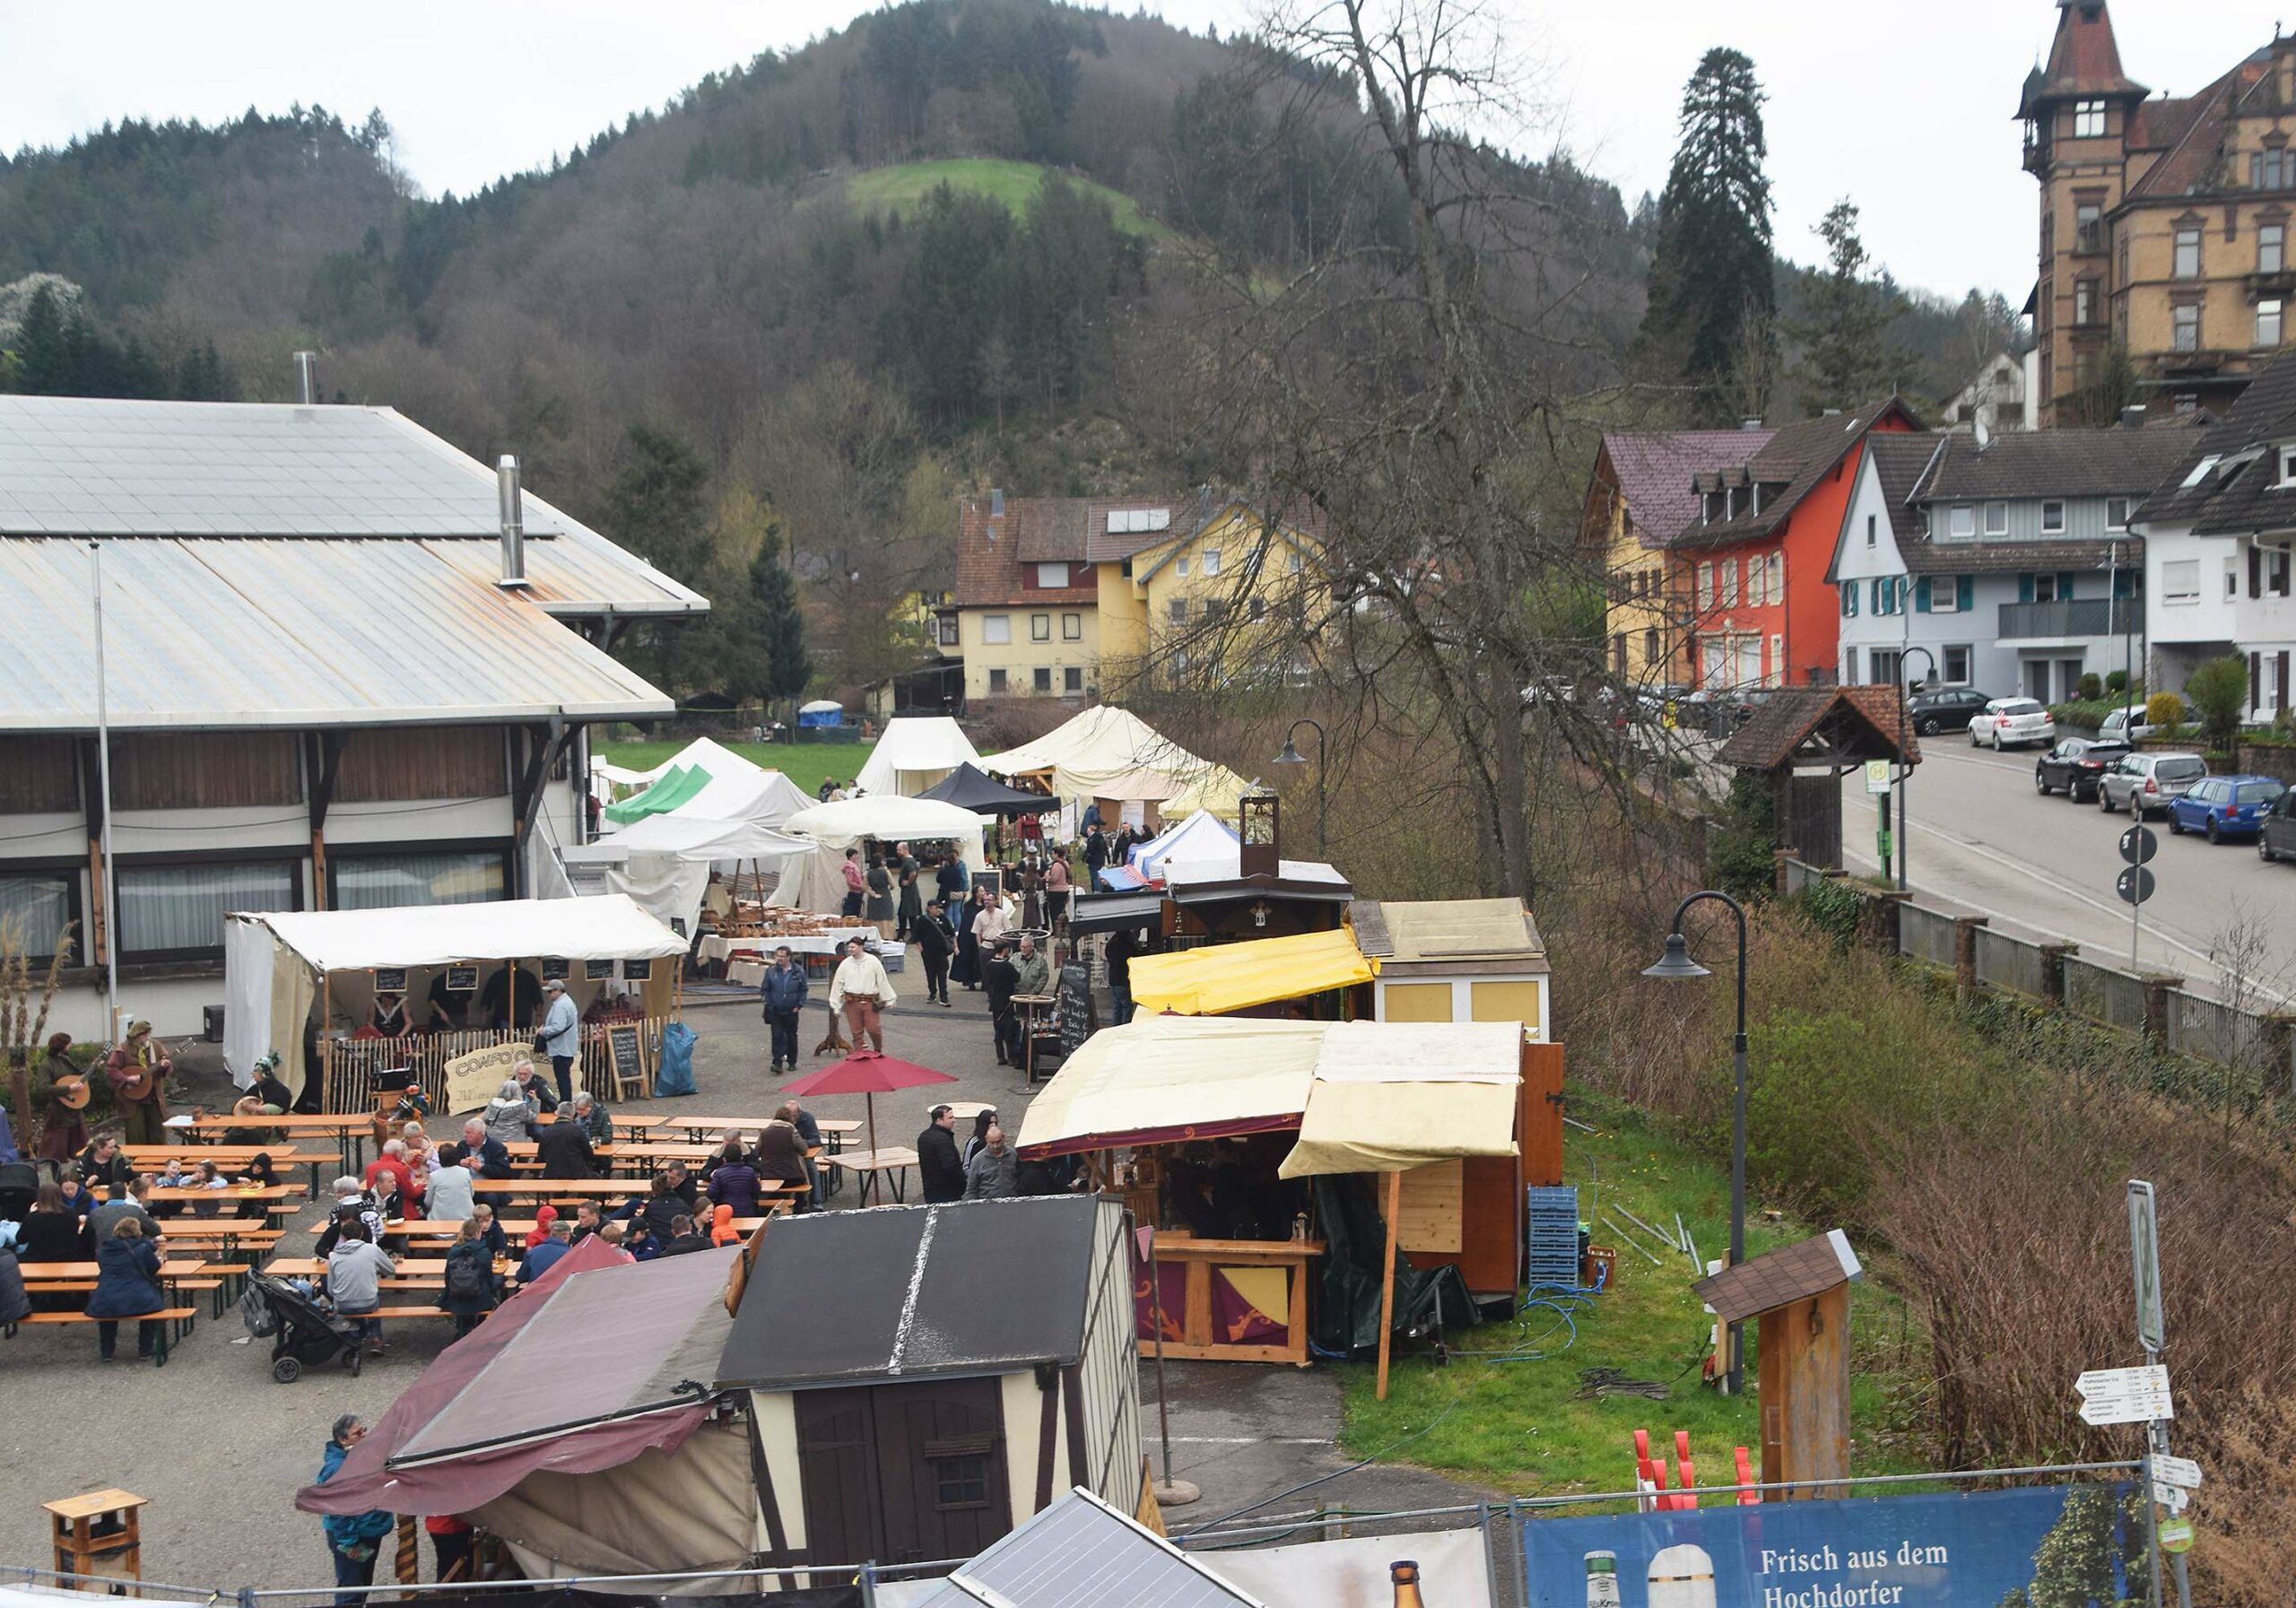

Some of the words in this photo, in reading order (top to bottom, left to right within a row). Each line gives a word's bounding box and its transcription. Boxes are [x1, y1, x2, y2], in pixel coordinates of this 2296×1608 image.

[1761, 1545, 1838, 1574] Frisch
[1848, 1549, 1888, 1569] aus
[1897, 1540, 1949, 1566] dem
[1763, 1579, 1903, 1608] Hochdorfer
